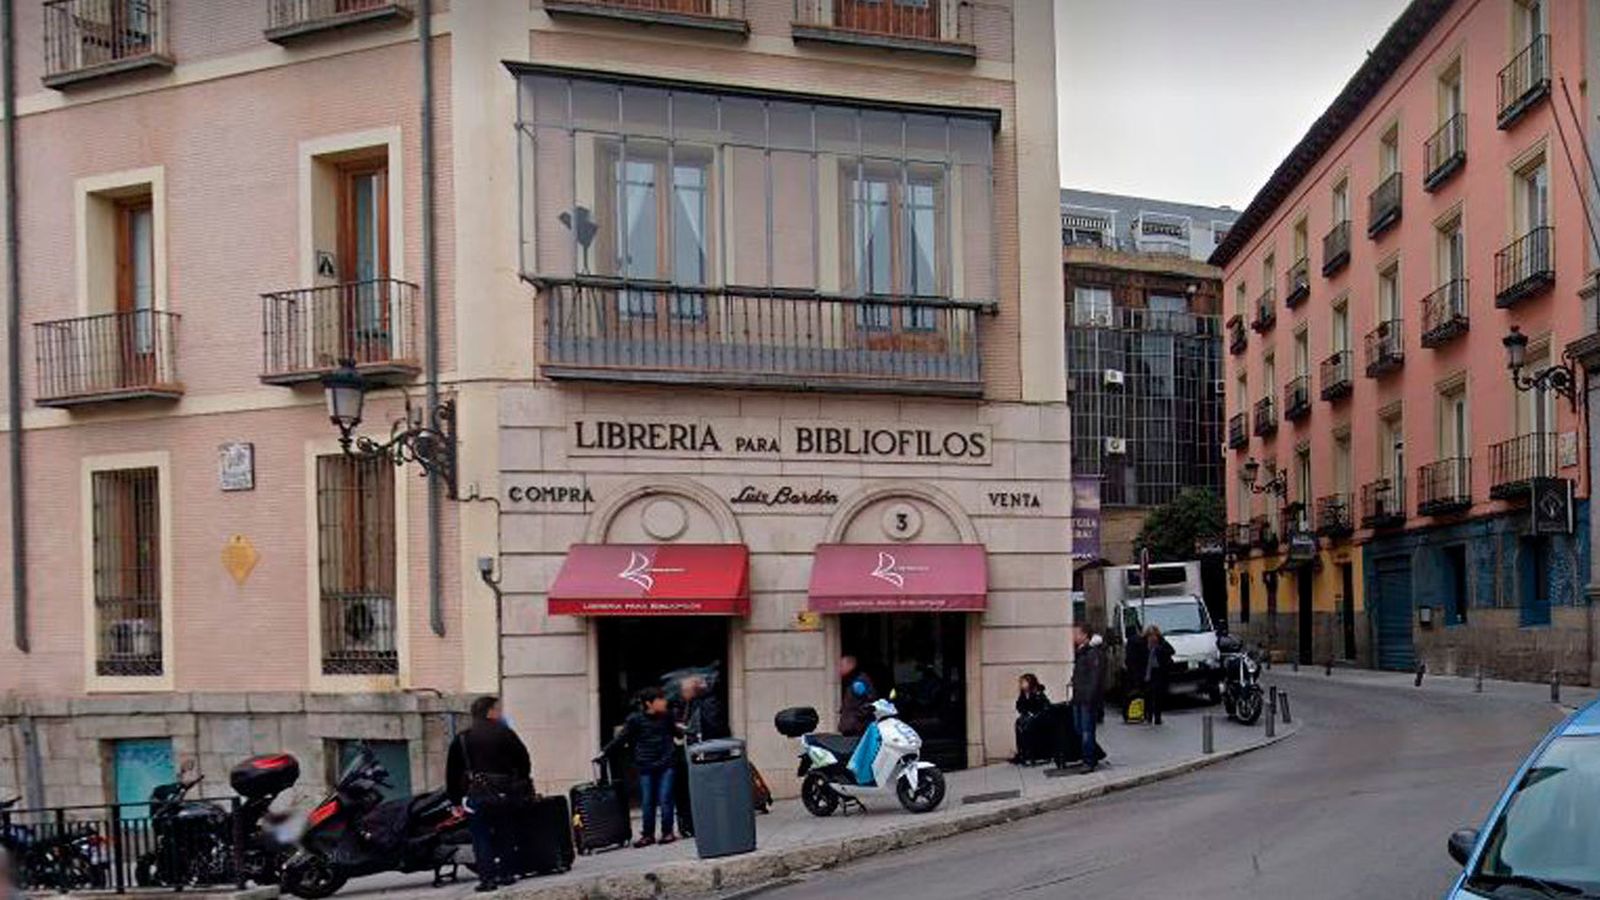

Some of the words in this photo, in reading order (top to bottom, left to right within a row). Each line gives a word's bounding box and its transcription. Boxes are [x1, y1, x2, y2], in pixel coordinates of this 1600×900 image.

[575, 421, 721, 451] LIBRERIA
[735, 437, 780, 453] PARA
[796, 427, 986, 457] BIBLIOFILOS
[508, 486, 596, 502] COMPRA
[731, 485, 769, 504] Luis
[988, 493, 1041, 507] VENTA
[896, 513, 908, 531] 3
